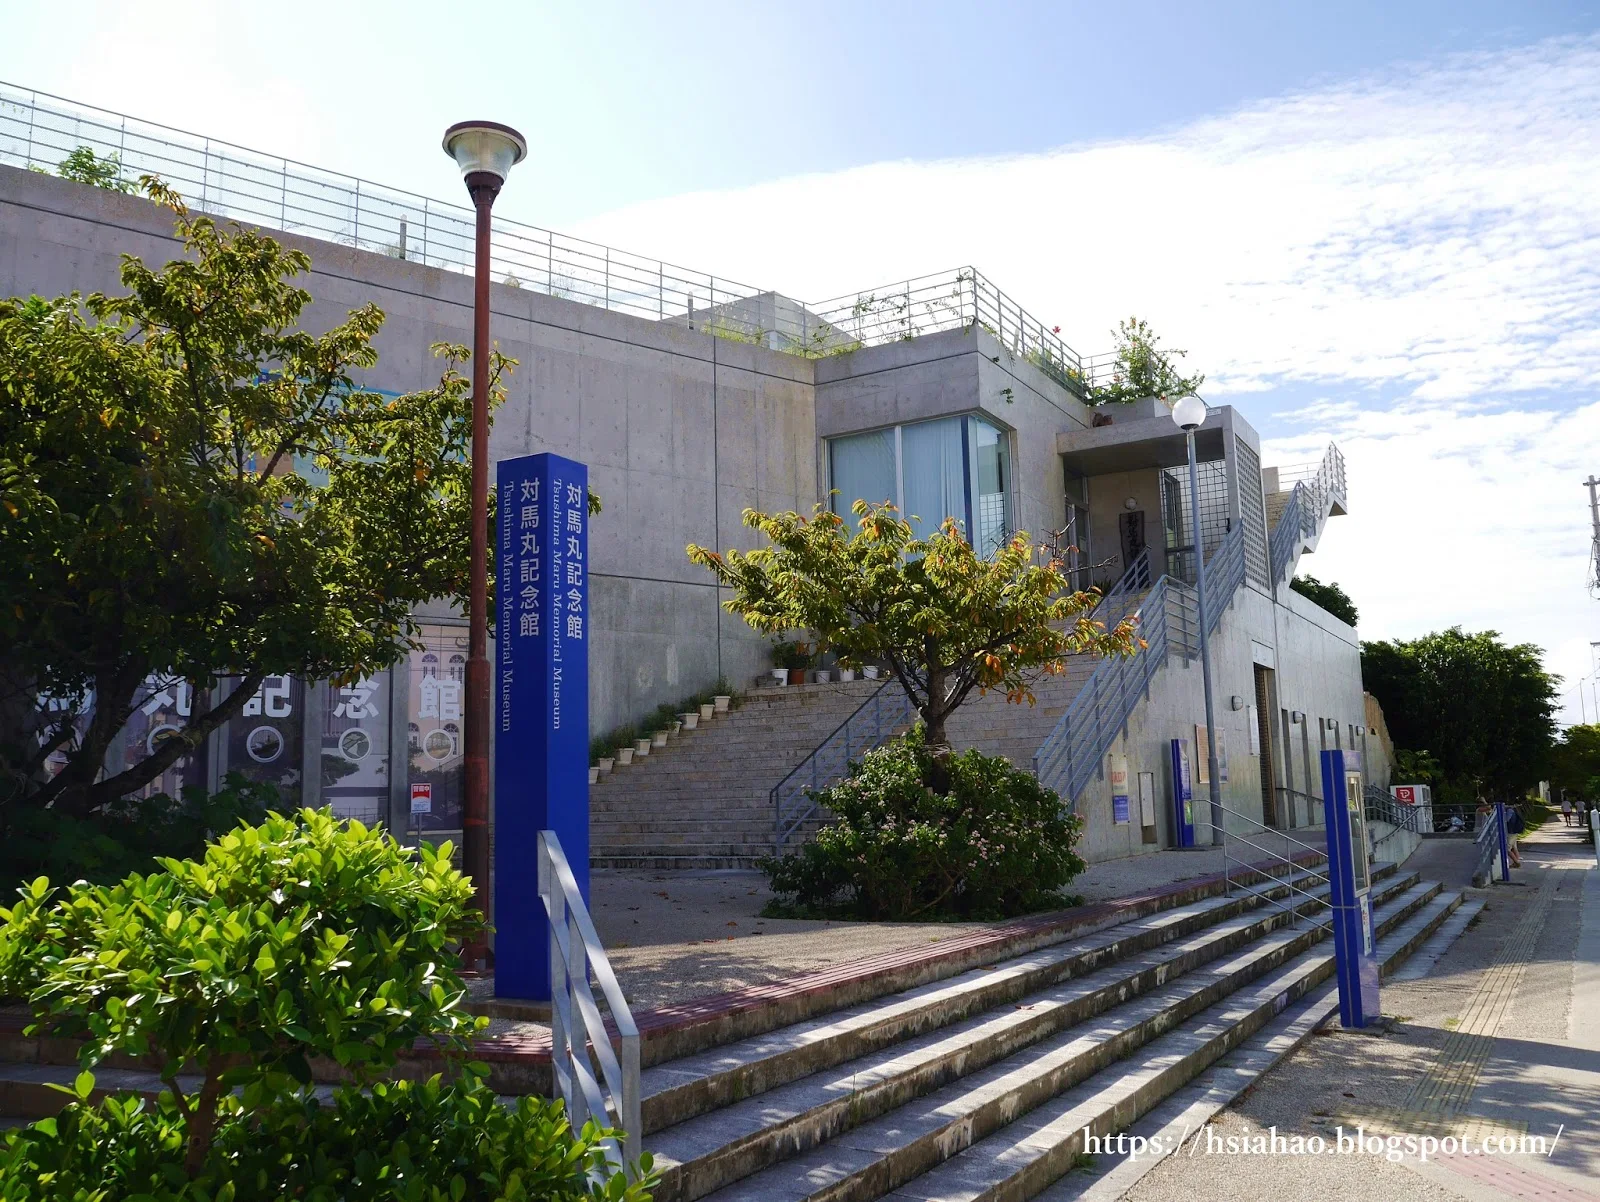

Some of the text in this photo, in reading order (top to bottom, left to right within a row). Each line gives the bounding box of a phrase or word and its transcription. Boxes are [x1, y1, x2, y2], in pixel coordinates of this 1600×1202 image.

[502, 480, 514, 732] Tsushima Maru Memorial Museum
[520, 477, 540, 637] 対馬丸記念館
[553, 479, 563, 730] Tsushima Maru Memorial Museum
[566, 482, 582, 640] 対馬丸記念館
